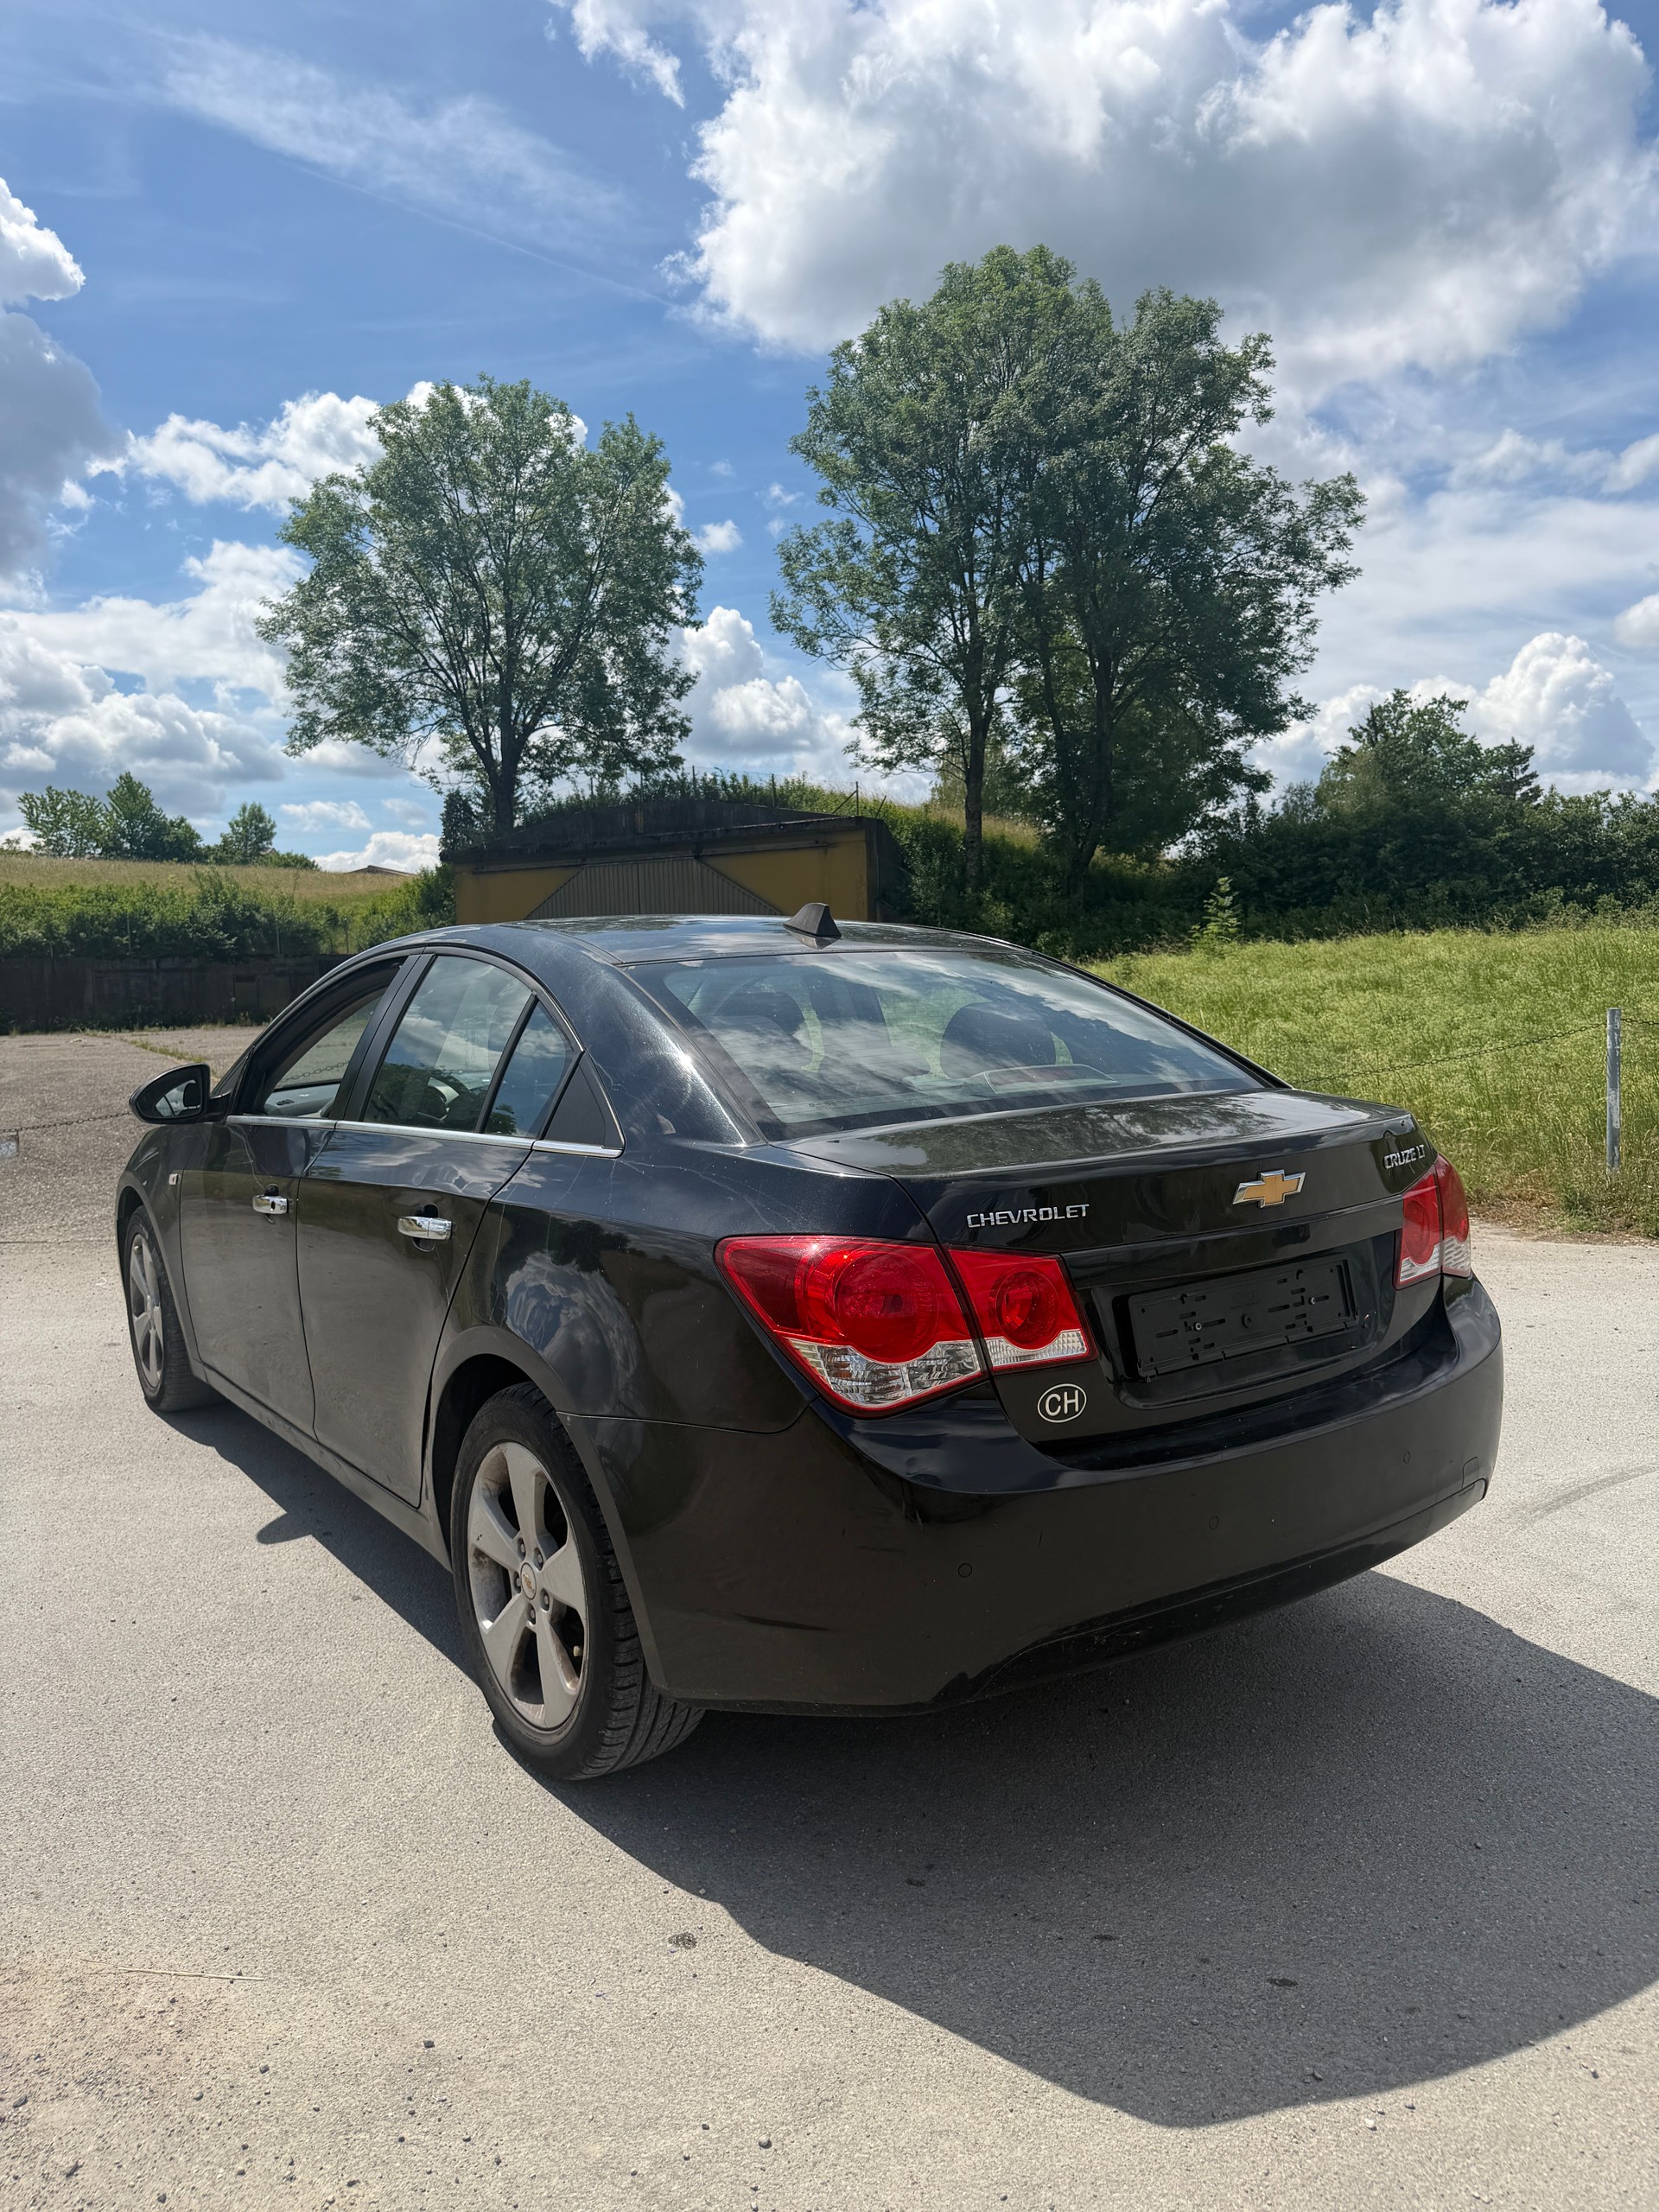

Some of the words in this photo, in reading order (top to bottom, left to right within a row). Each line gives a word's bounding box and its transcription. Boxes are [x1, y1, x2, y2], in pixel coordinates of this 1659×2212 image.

[1383, 1147, 1417, 1169] CRUZE
[1416, 1144, 1426, 1160] LT
[966, 1204, 1090, 1228] CHEVROLET
[1045, 1389, 1079, 1416] CH
